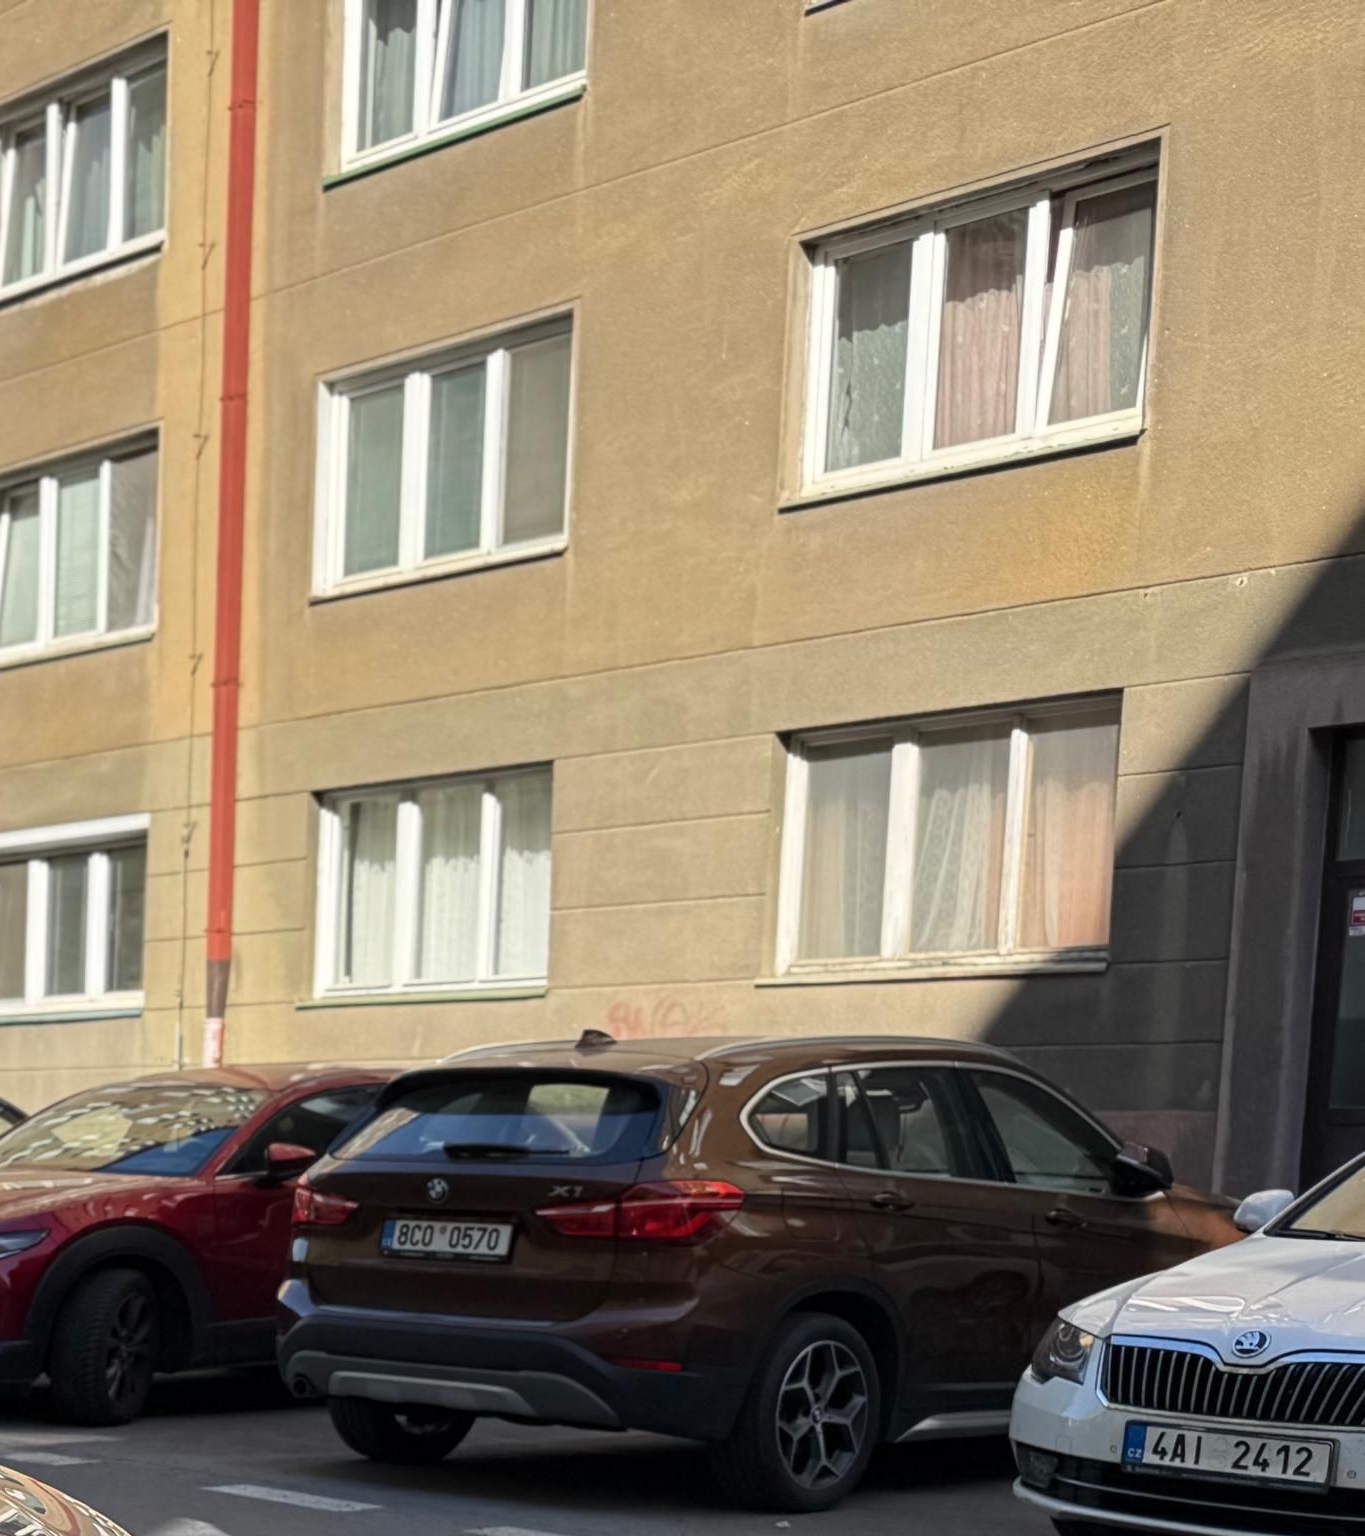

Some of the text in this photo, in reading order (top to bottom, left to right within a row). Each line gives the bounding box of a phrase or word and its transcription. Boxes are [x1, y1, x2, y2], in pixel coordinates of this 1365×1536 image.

[548, 1185, 584, 1198] X1
[449, 1226, 500, 1251] 0570
[1127, 1448, 1142, 1459] CZ
[1152, 1431, 1202, 1465] 4AI
[1231, 1440, 1313, 1478] 2412
